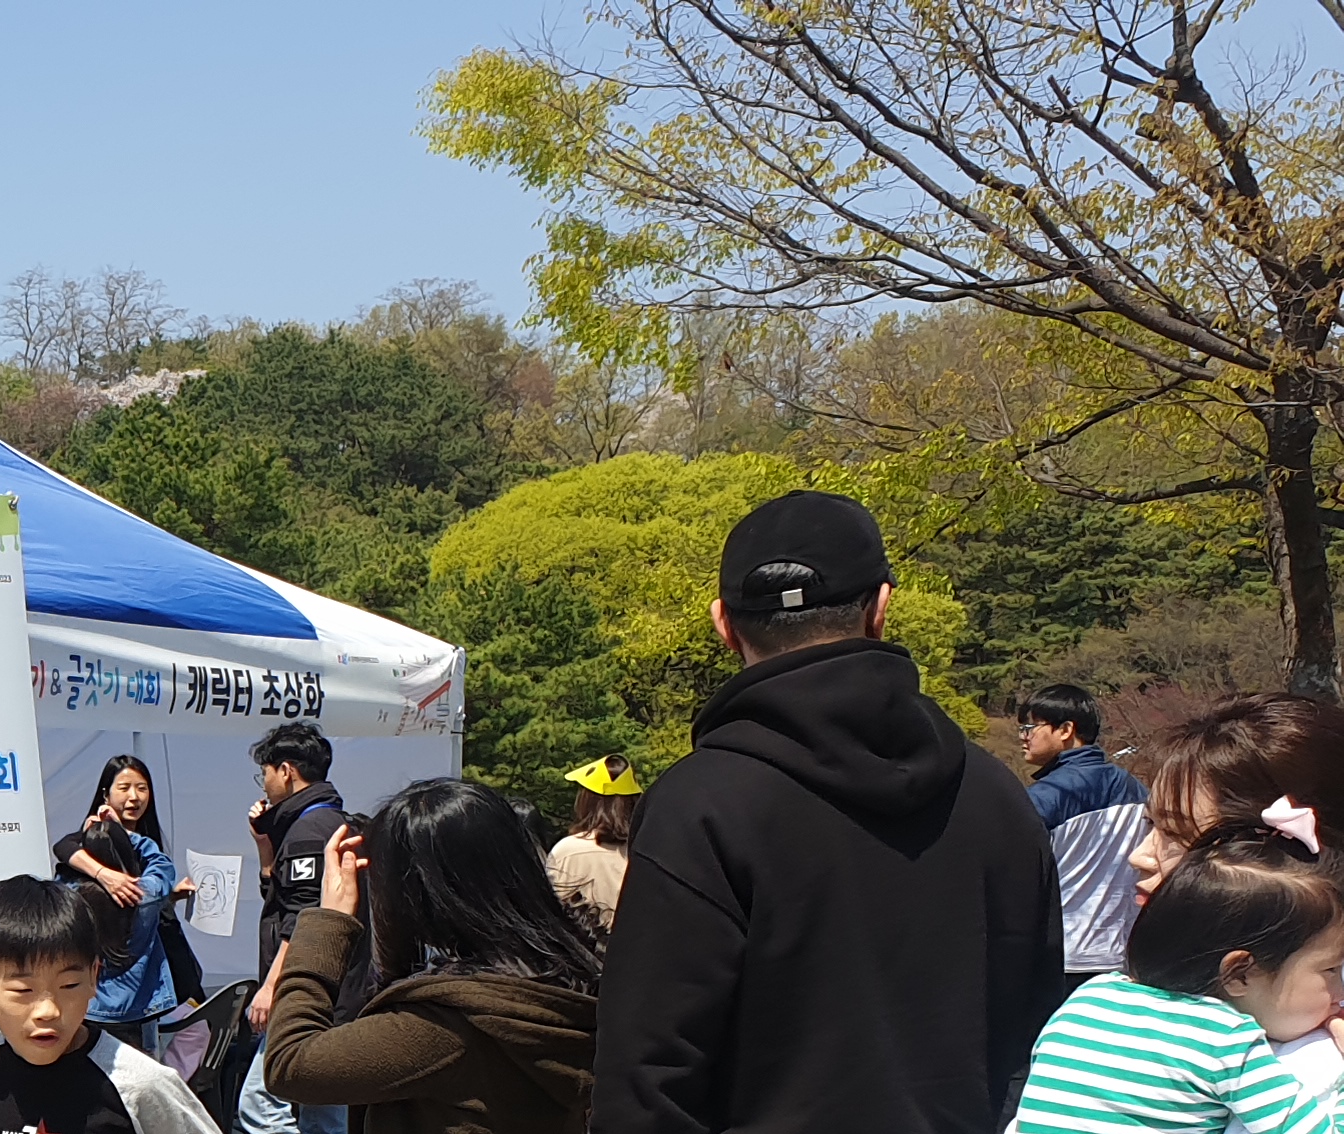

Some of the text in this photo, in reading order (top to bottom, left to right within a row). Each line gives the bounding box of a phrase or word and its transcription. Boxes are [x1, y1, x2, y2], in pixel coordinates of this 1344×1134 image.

[51, 668, 62, 696] &
[67, 654, 120, 711] 글짓기
[127, 669, 161, 706] 대회
[185, 665, 253, 717] 캐릭터
[260, 668, 325, 719] 초상화
